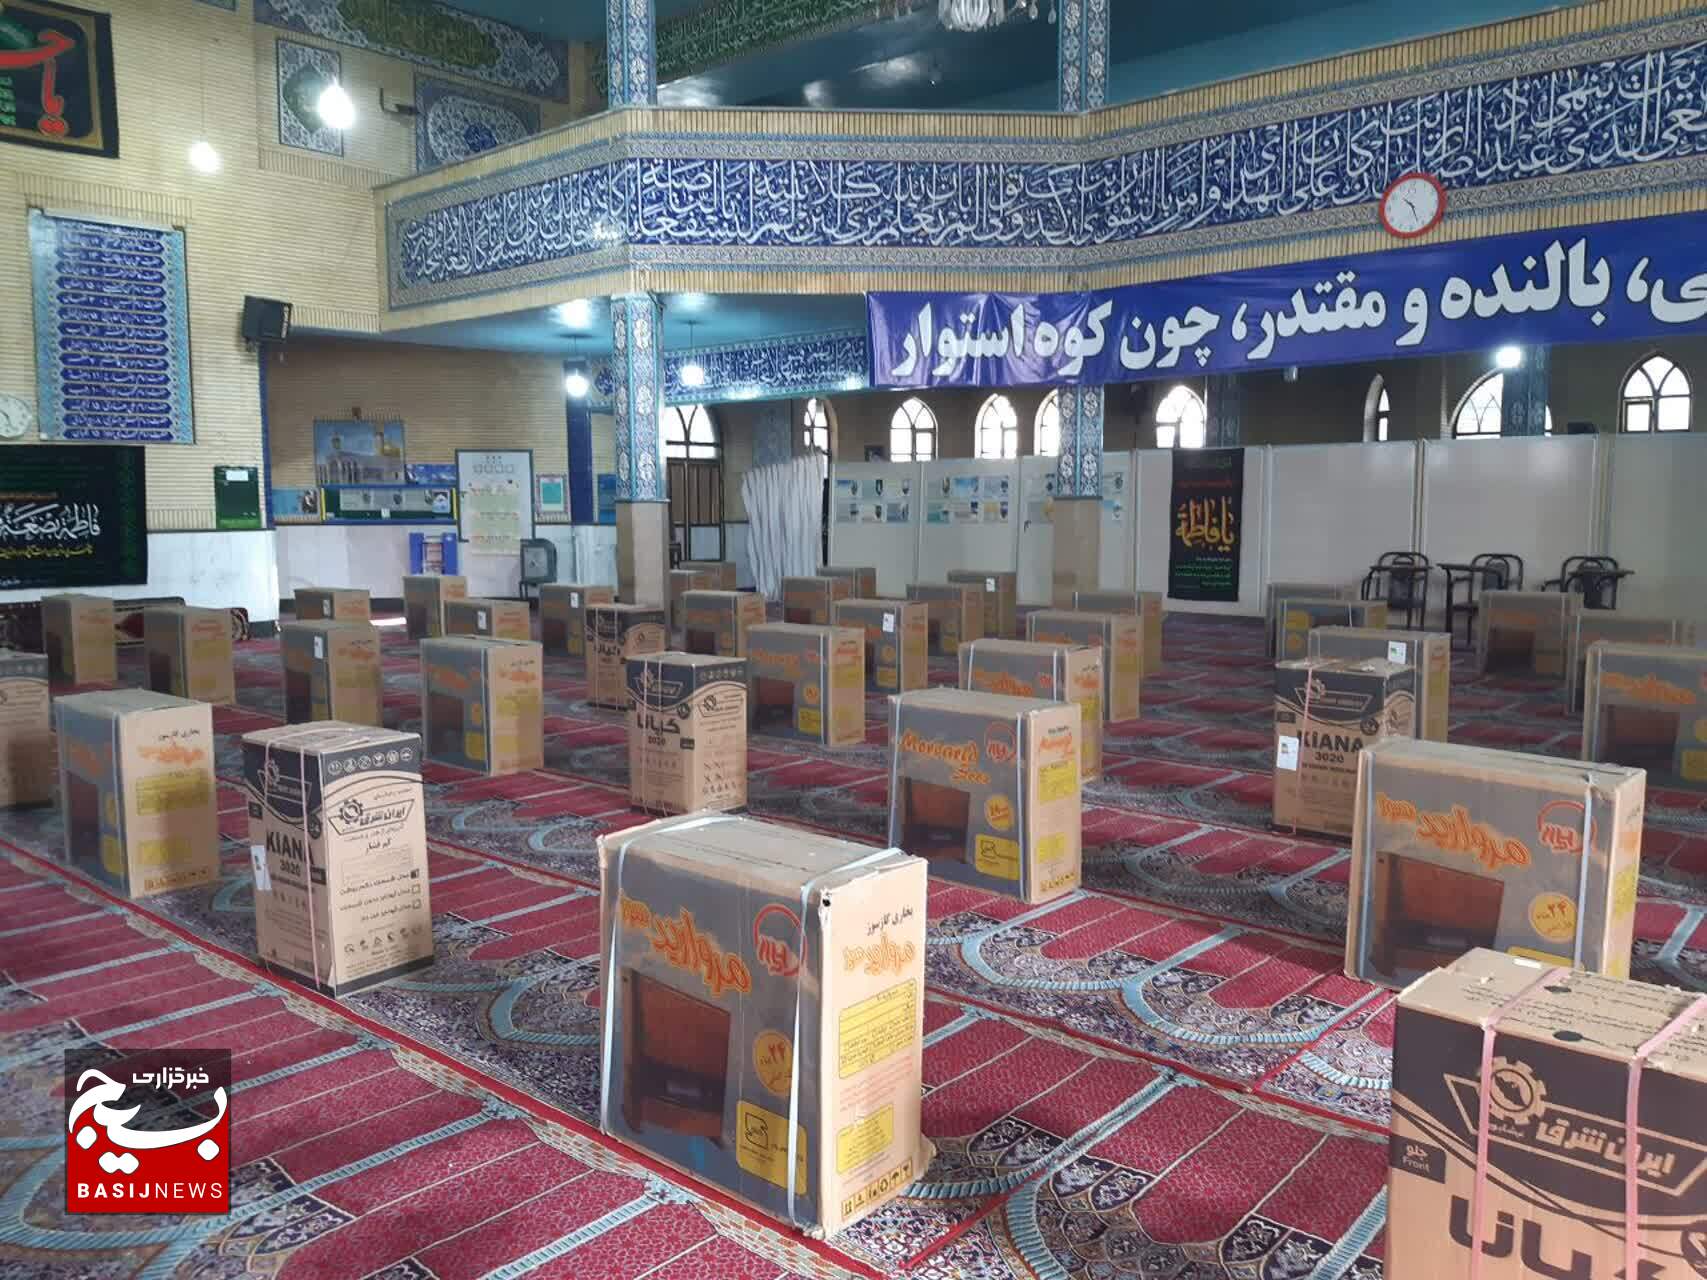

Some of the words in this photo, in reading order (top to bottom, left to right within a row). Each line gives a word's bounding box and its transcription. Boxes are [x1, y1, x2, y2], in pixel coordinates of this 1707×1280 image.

[1440, 238, 1610, 326] بالنده
[1627, 257, 1707, 323] ی،
[1232, 270, 1387, 360] مقتدر،
[1395, 288, 1429, 346] و
[891, 303, 1024, 377] استوار
[1035, 300, 1113, 376] کوه
[1119, 306, 1220, 369] چون
[1296, 730, 1364, 753] KIANA
[1315, 752, 1345, 764] 3020
[266, 831, 315, 866] KIANA
[280, 860, 301, 877] 3020
[891, 905, 914, 926] بخاری
[1406, 1143, 1429, 1159] جلو
[1535, 1118, 1604, 1154] شرق
[1402, 1155, 1430, 1173] Front
